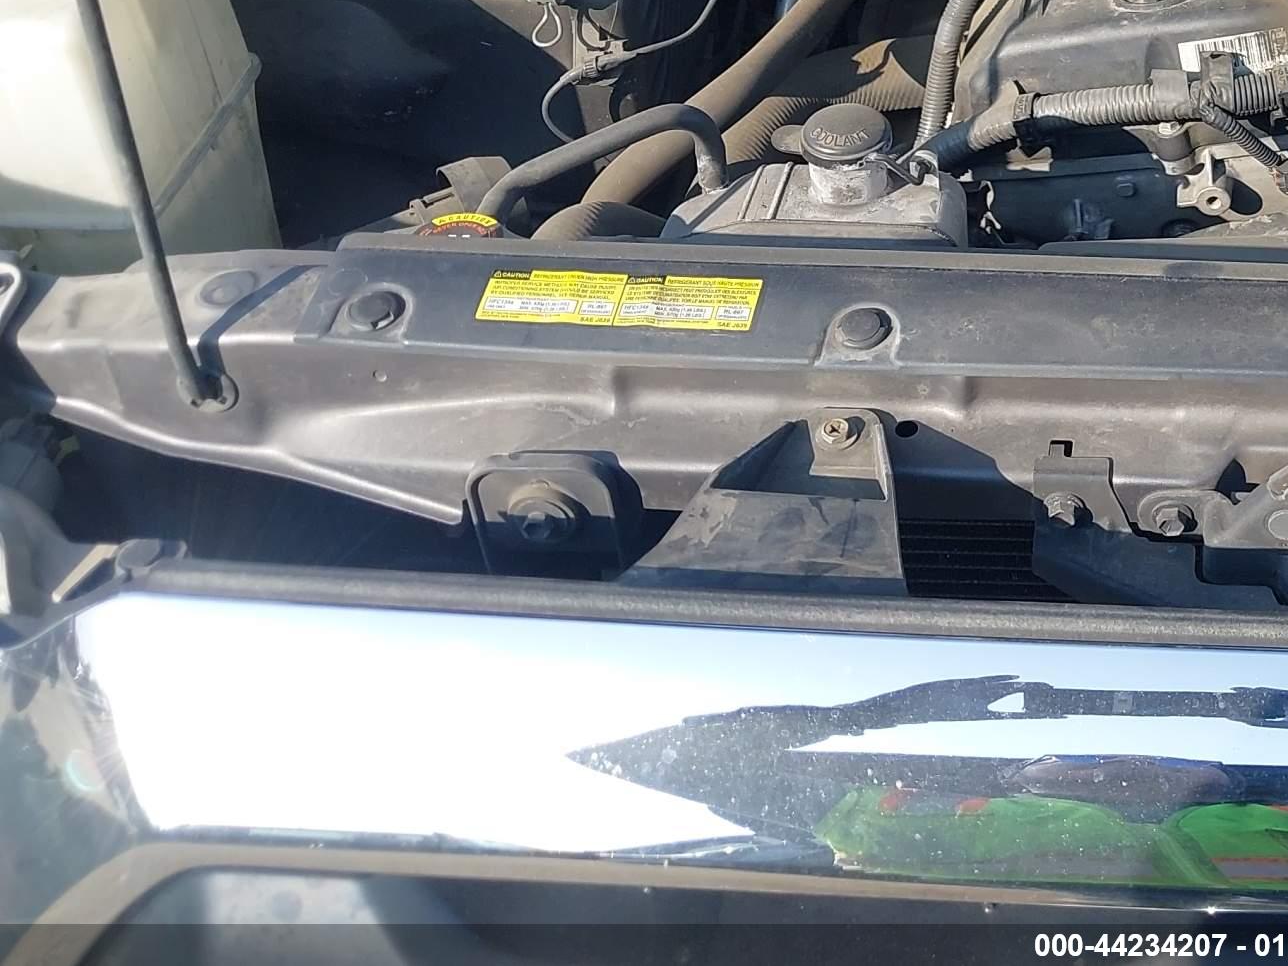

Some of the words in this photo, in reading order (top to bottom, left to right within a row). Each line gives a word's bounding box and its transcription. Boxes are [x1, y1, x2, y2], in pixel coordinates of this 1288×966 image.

[810, 126, 871, 147] COOLANT
[448, 215, 493, 224] CAUTION
[502, 271, 530, 279] CAUTION
